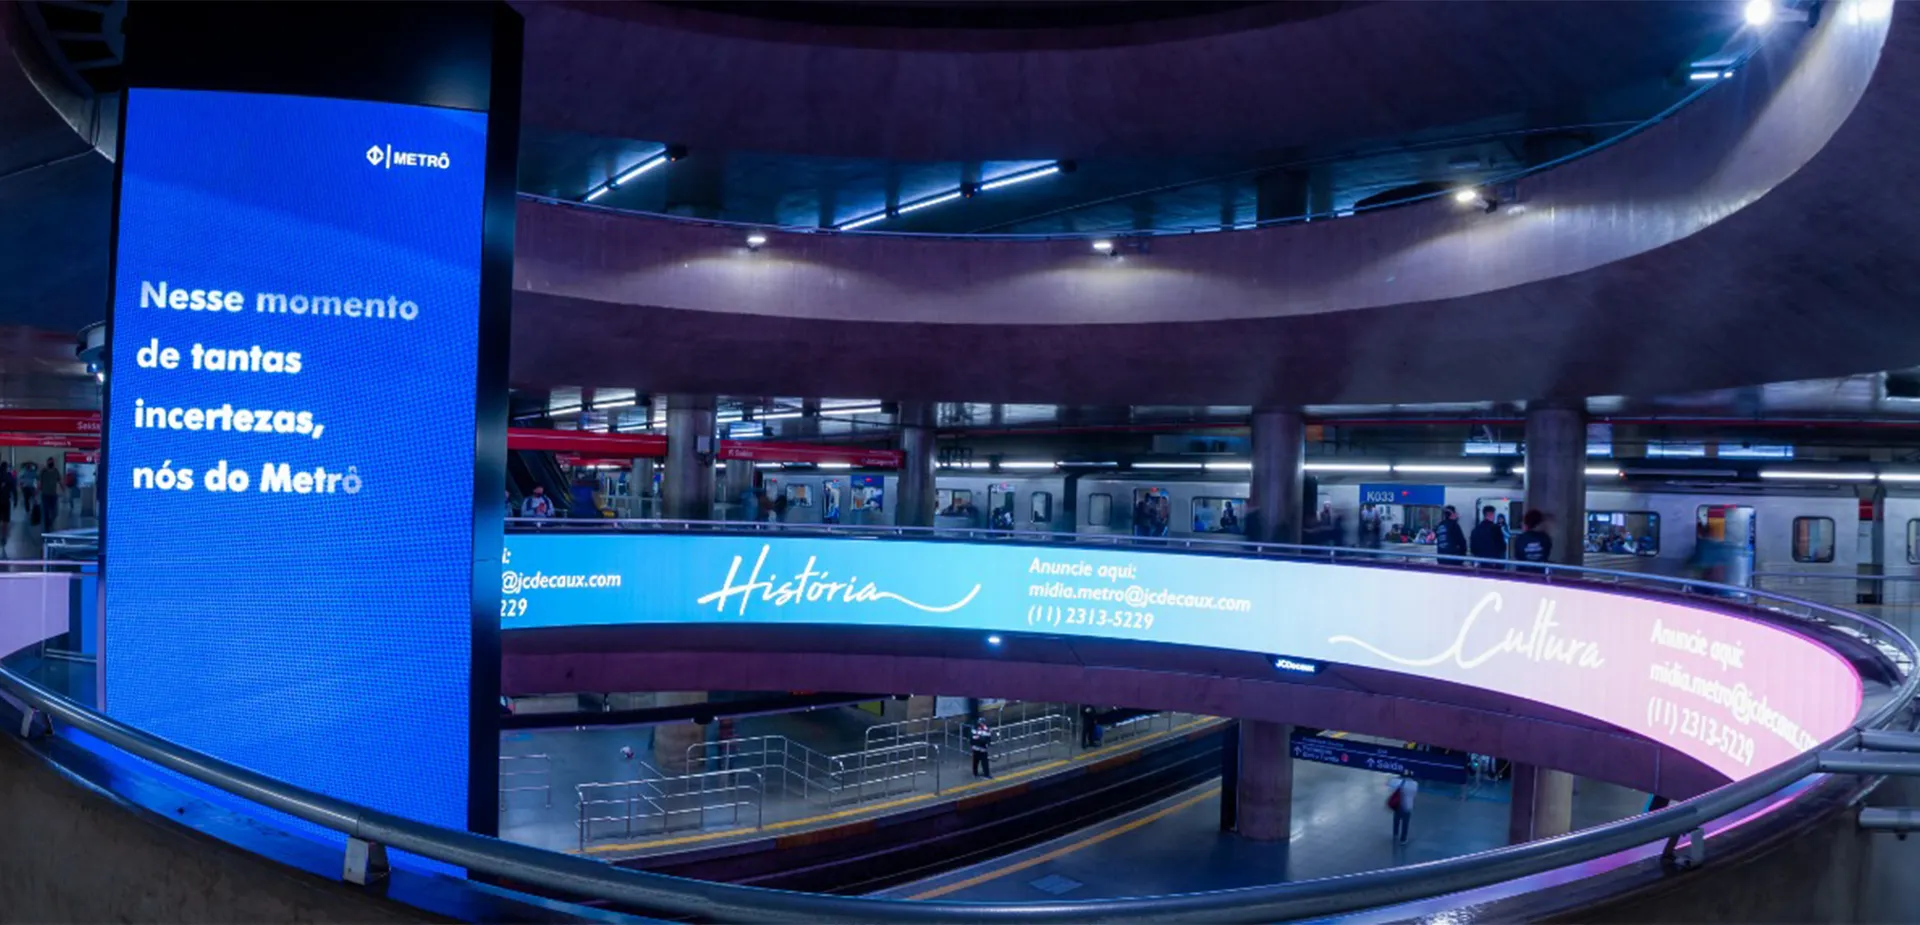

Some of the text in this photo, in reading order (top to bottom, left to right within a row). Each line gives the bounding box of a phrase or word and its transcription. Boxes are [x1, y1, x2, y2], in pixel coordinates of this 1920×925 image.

[394, 152, 450, 169] METRÔ
[140, 280, 419, 321] Nesse momento
[136, 338, 302, 374] de tantas
[134, 398, 324, 439] incertezas,
[132, 460, 362, 495] nós do Metrô
[1367, 491, 1395, 502] K033
[698, 544, 980, 616] História
[1028, 557, 1137, 583] Anuncie aqui:
[1028, 581, 1251, 613] midia.metro@jcdecaux.com
[1027, 605, 1154, 630] (11) 2313-5229
[1328, 591, 1605, 670] Cultura
[1650, 618, 1744, 671] Anuncie aqui:
[1647, 696, 1755, 767] (11) 2313-5229
